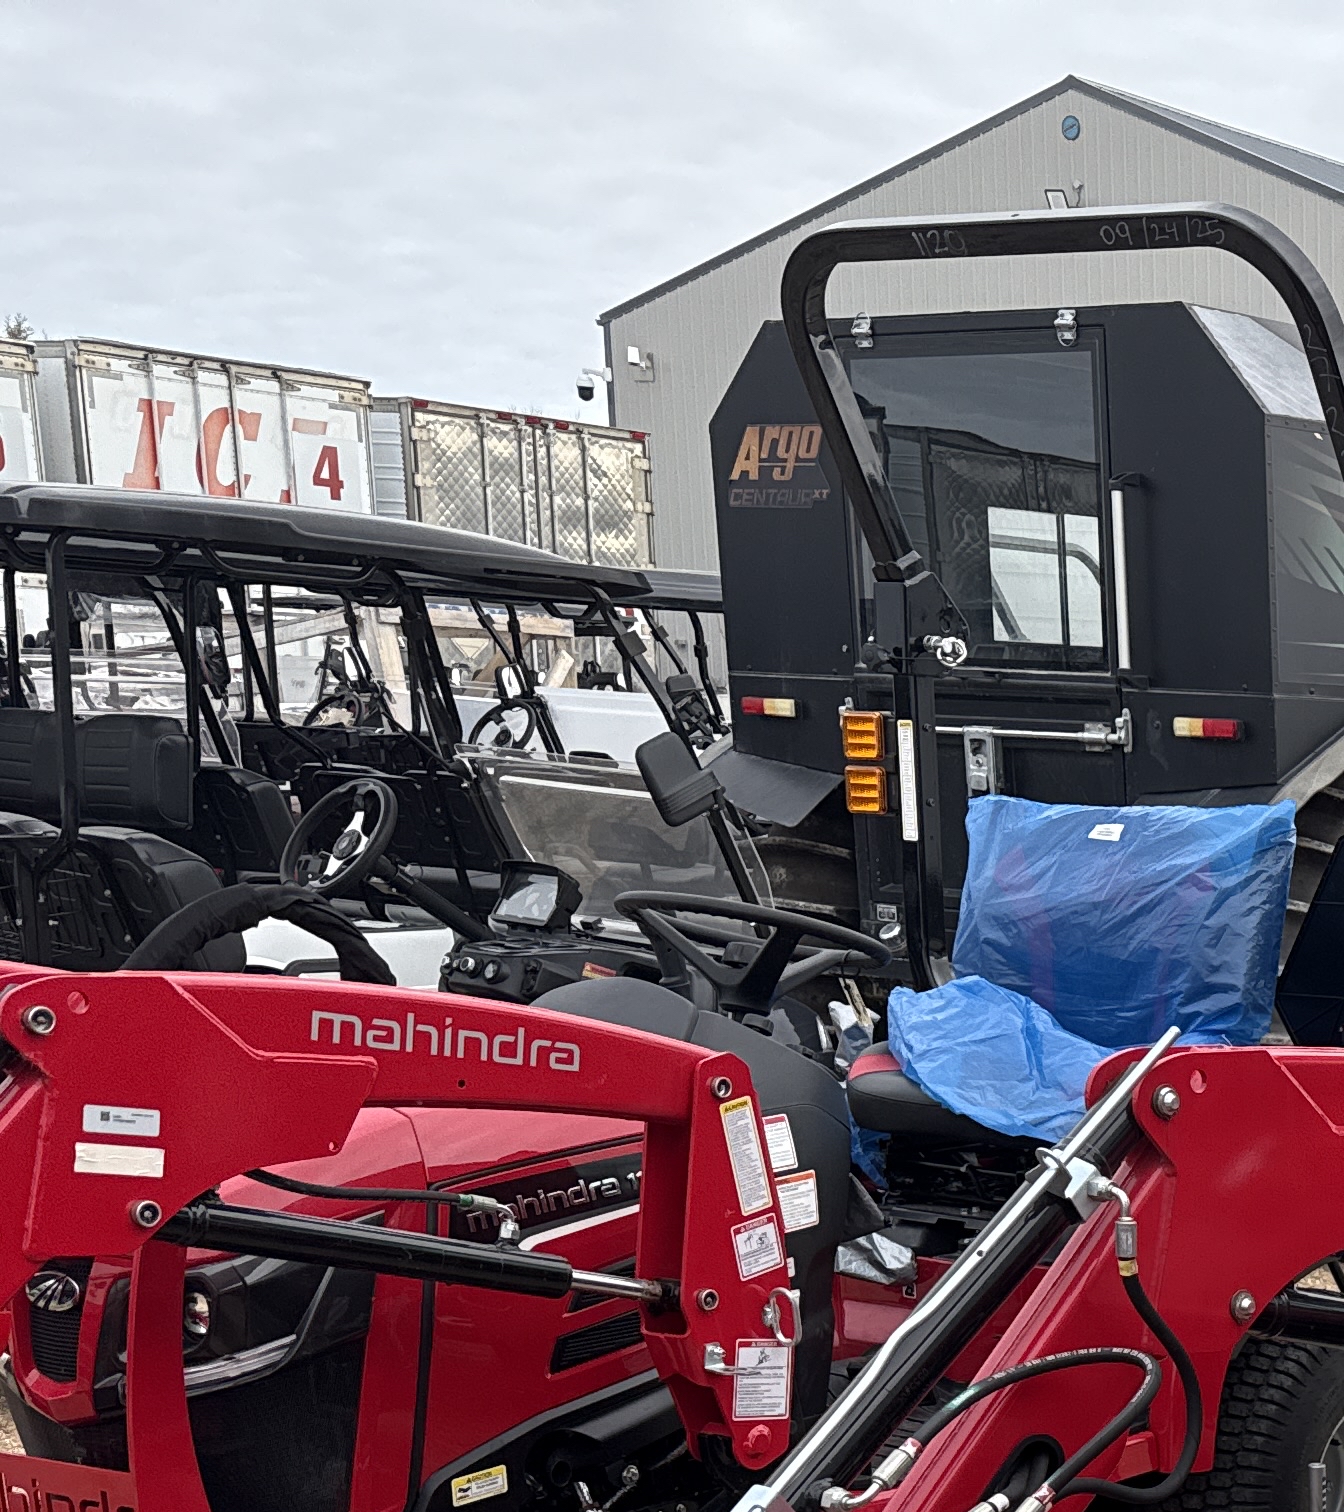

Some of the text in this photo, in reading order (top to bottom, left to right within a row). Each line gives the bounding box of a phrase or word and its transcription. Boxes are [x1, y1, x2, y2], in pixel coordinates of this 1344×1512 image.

[1100, 215, 1226, 246] 09/24/25
[312, 444, 345, 501] 4
[729, 425, 823, 481] Argo
[310, 1009, 582, 1072] mahindra
